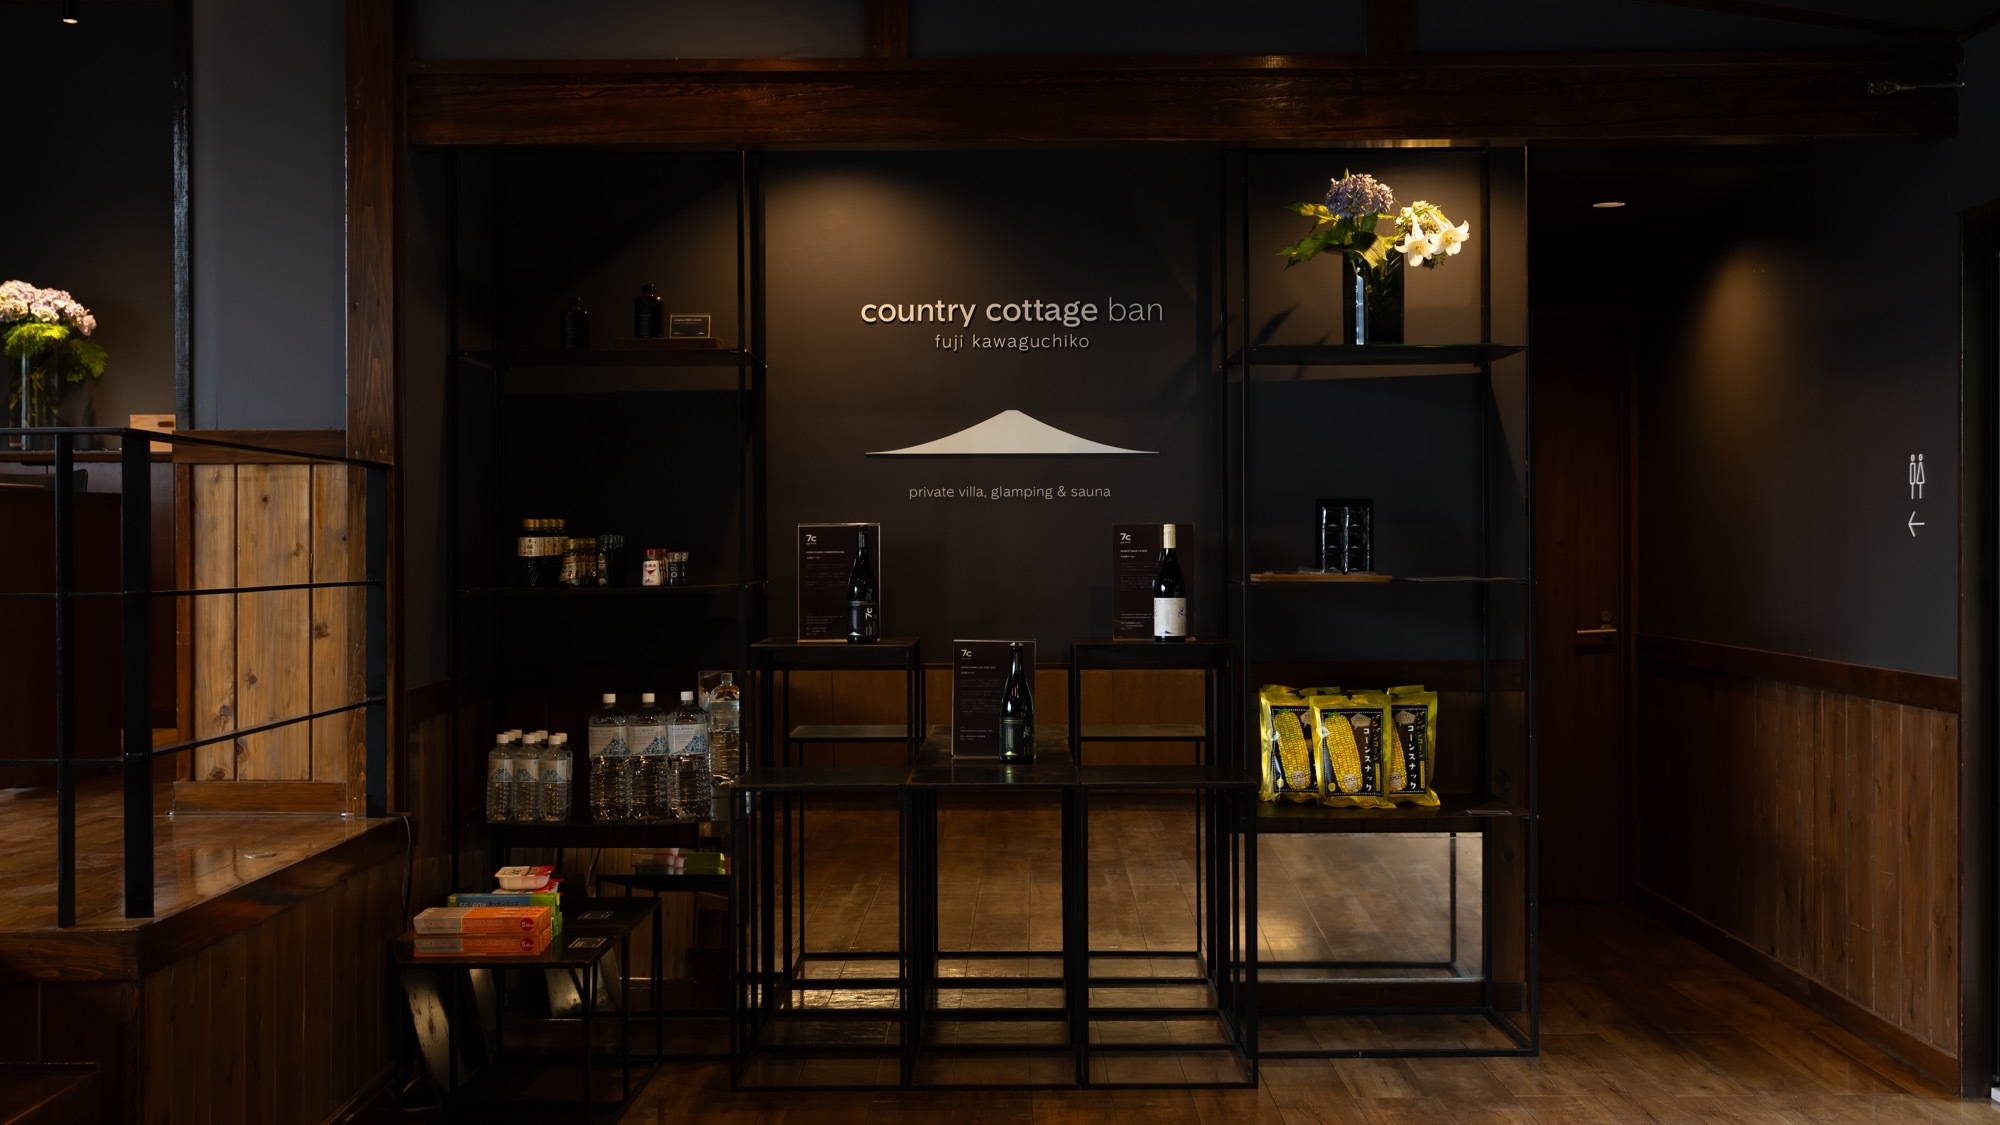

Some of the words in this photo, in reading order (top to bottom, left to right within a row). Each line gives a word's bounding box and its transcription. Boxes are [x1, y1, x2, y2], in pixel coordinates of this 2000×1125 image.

[860, 299, 977, 328] country
[985, 299, 1098, 328] cottage
[1108, 297, 1164, 322] ban
[934, 334, 965, 352] fuji
[972, 334, 1091, 352] kawaguchiko
[909, 486, 955, 500] private
[959, 485, 988, 499] villa,
[991, 485, 1054, 500] glamping
[1057, 486, 1068, 498] &
[1070, 488, 1112, 498] sauna
[806, 534, 817, 543] 7c
[1120, 533, 1131, 541] 7c
[961, 649, 972, 658] 7c
[1363, 728, 1372, 792] コーンスナック
[1407, 725, 1417, 790] コーンスナック
